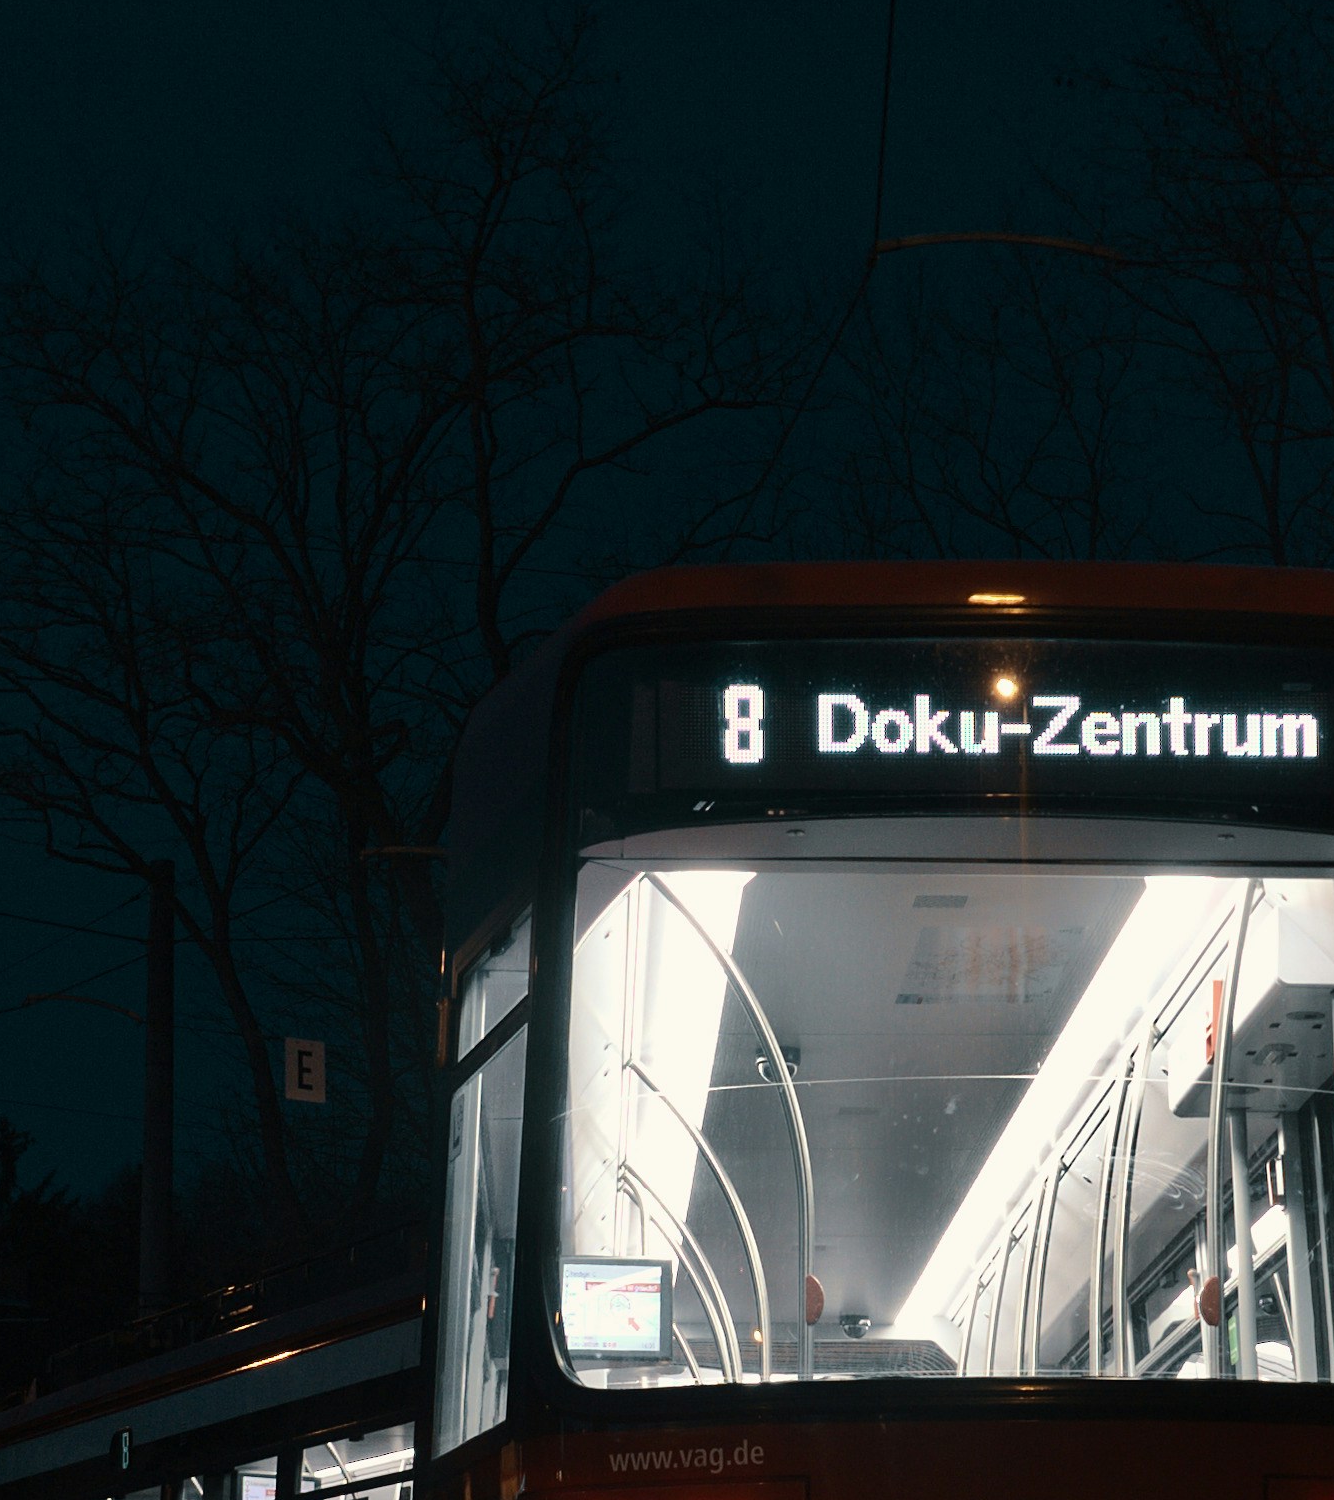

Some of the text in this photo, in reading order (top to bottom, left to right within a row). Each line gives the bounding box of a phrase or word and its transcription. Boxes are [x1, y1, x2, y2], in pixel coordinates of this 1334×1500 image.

[722, 684, 1319, 763] 8 Doku-Zentrum
[298, 1050, 313, 1090] E
[609, 1439, 764, 1474] www.vag.de
